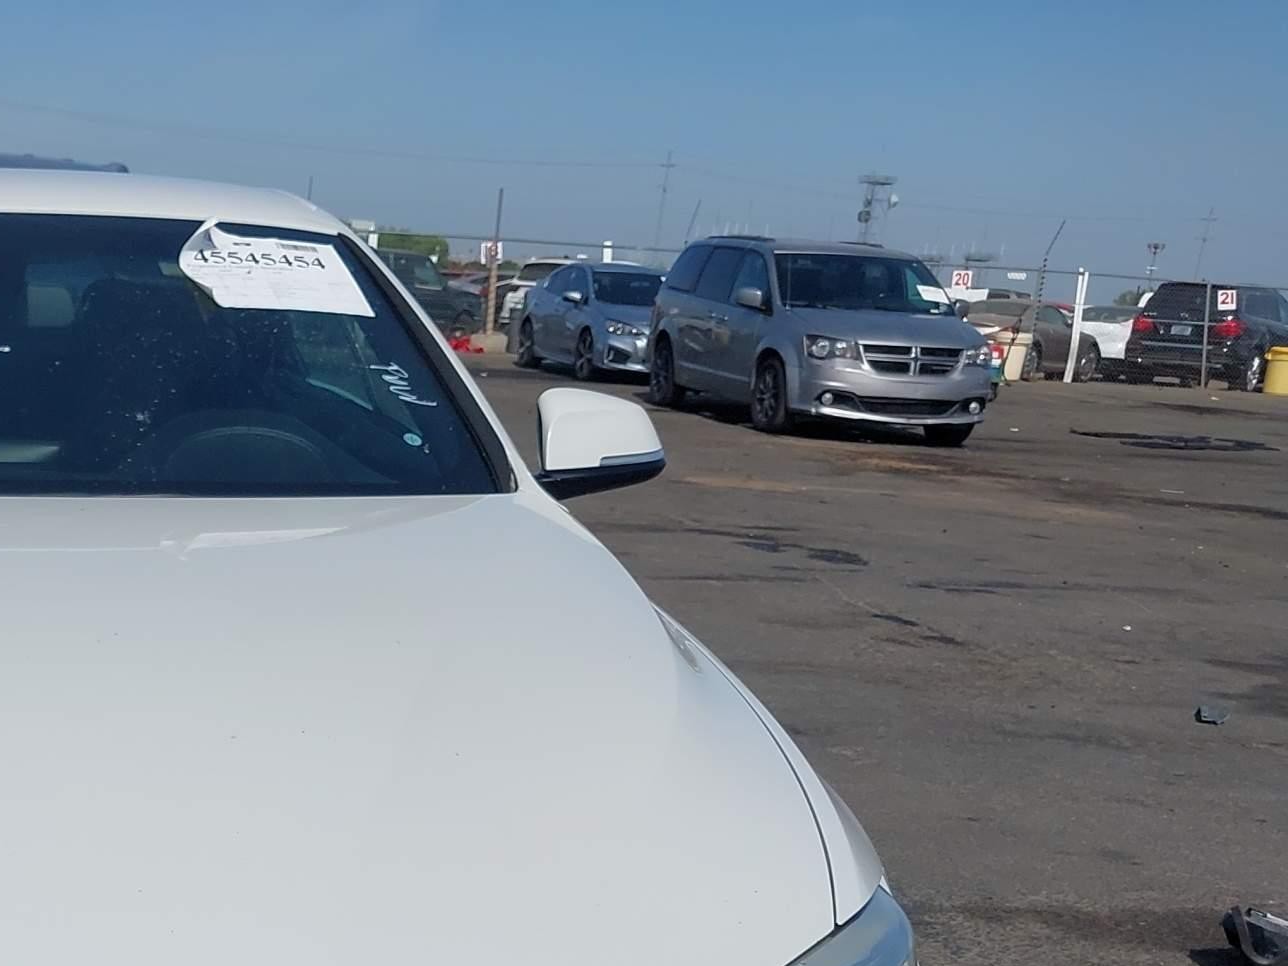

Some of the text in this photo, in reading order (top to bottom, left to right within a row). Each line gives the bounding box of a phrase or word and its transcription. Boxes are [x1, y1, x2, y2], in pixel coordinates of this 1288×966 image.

[193, 248, 326, 270] 45545454
[954, 272, 970, 287] 20
[1219, 291, 1235, 305] 21
